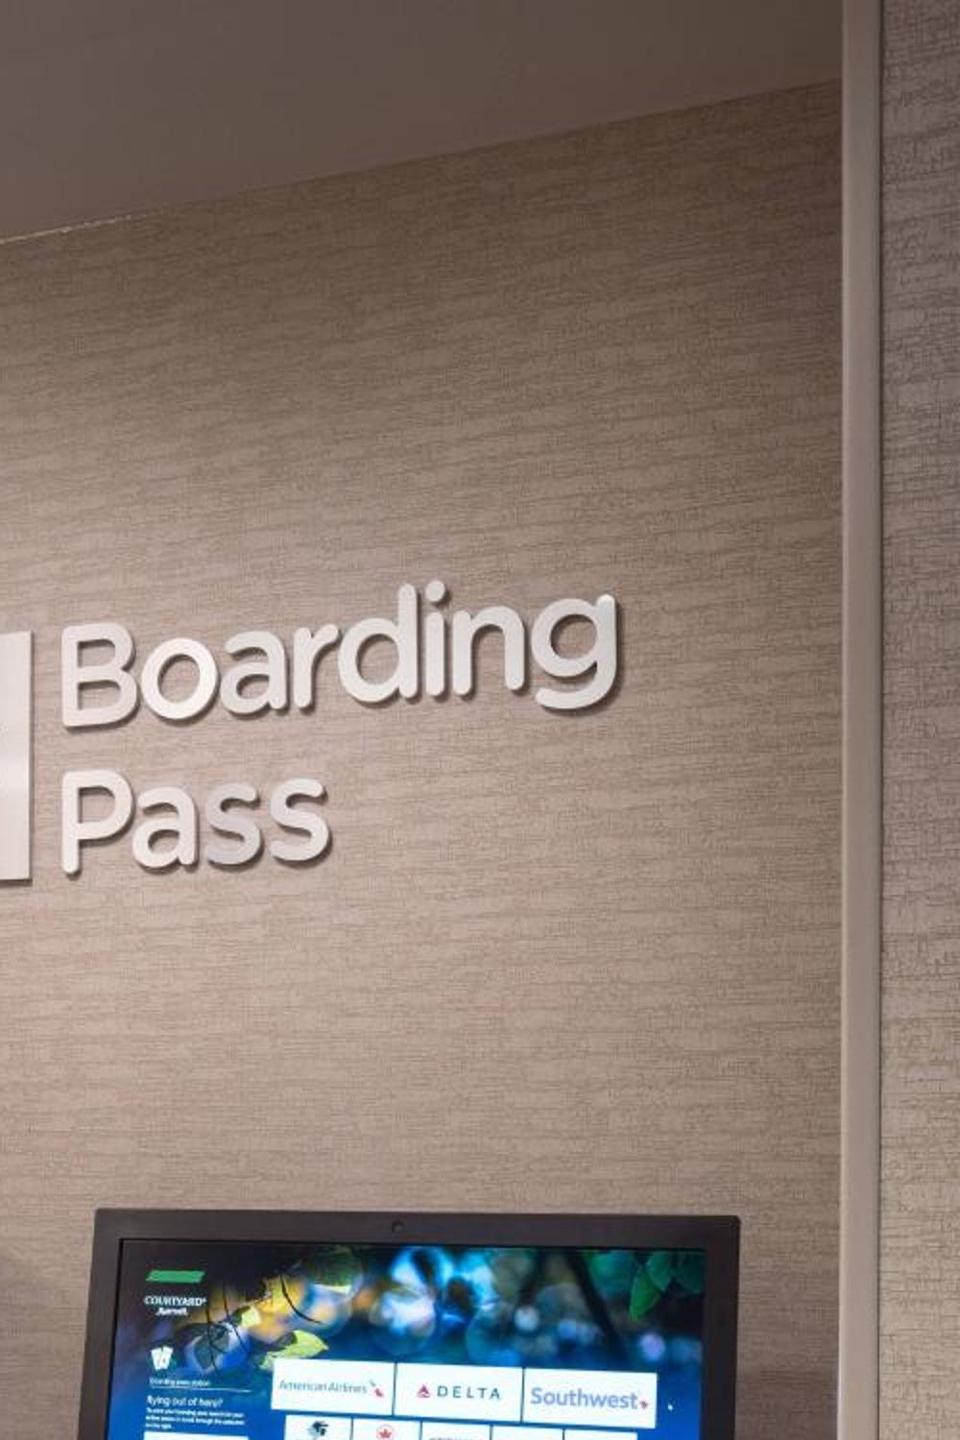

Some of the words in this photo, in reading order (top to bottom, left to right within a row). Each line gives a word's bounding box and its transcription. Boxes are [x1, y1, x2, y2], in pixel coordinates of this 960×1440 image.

[60, 580, 618, 728] Boarding
[60, 769, 331, 875] Pass
[437, 1385, 501, 1401] DELTA
[530, 1386, 638, 1410] Southwest
